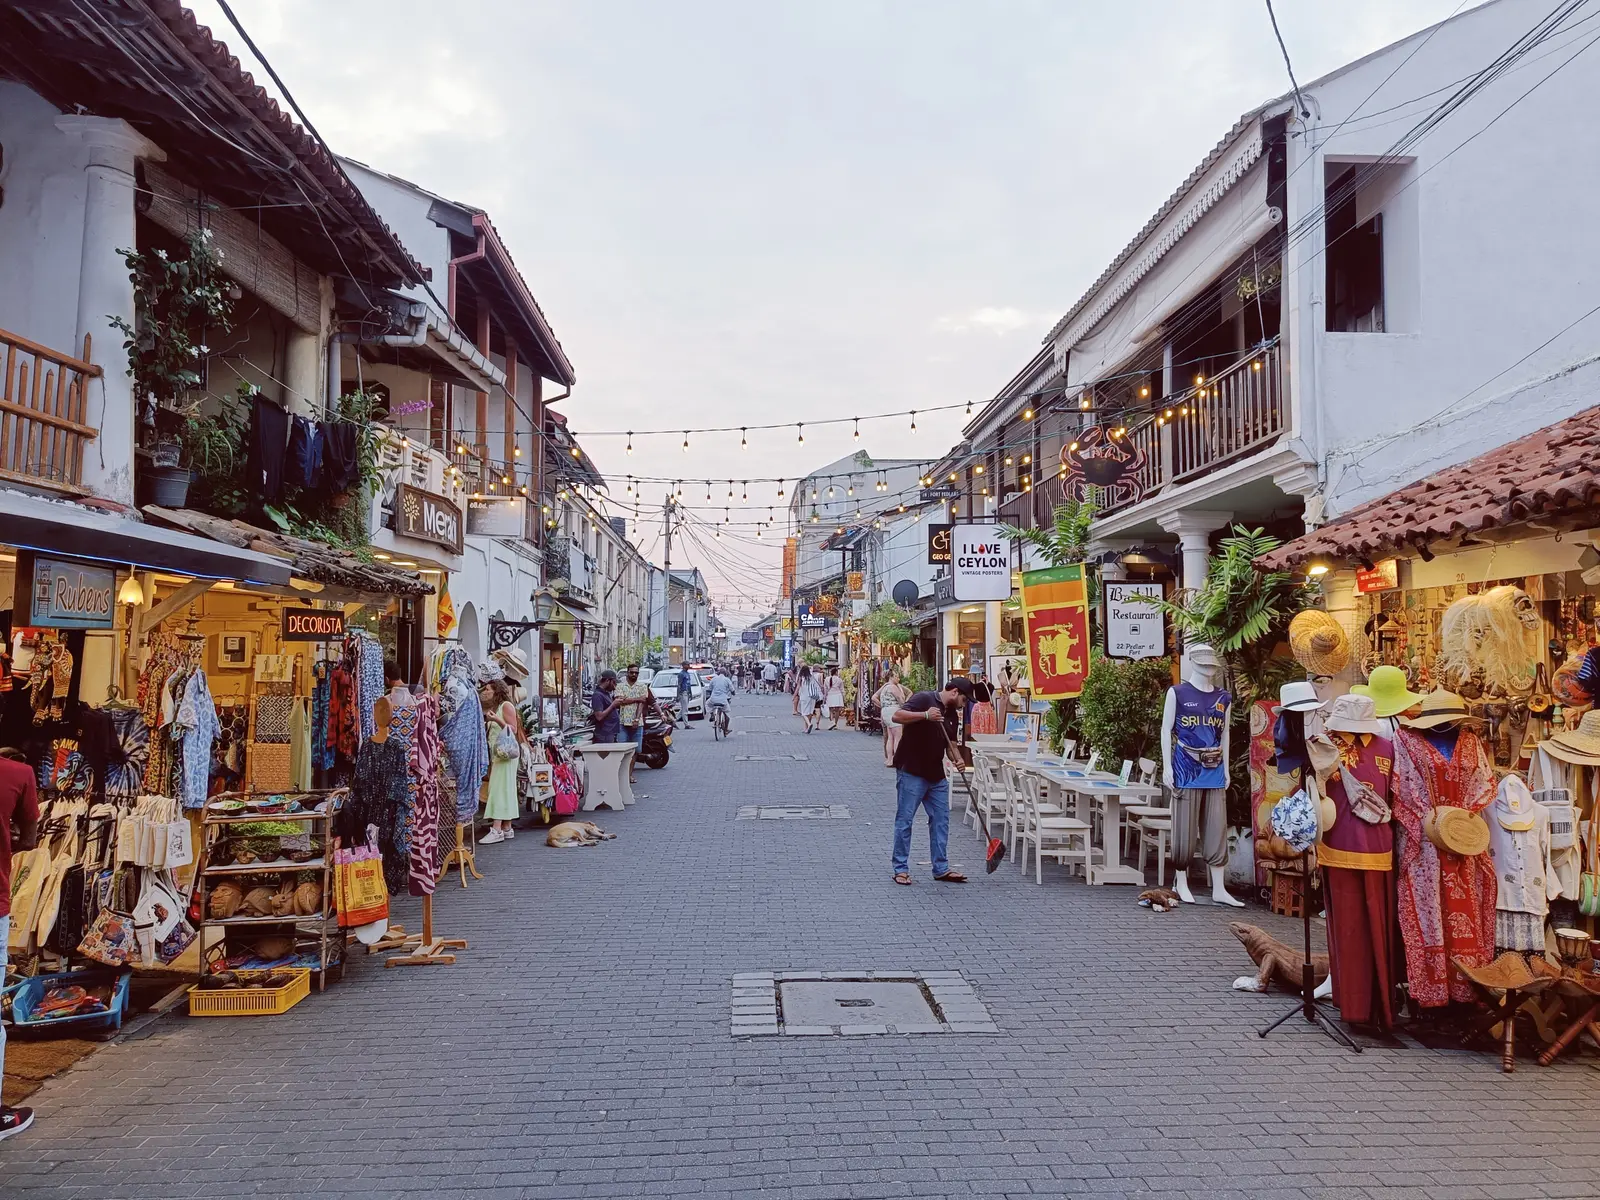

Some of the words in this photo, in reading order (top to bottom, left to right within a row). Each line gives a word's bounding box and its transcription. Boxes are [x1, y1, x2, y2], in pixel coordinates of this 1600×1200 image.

[963, 544, 967, 554] I
[958, 557, 1007, 568] CEYLON
[1456, 573, 1465, 582] 20
[54, 572, 110, 615] Rubens
[288, 616, 342, 634] DECORISTA
[1181, 716, 1200, 727] SRI
